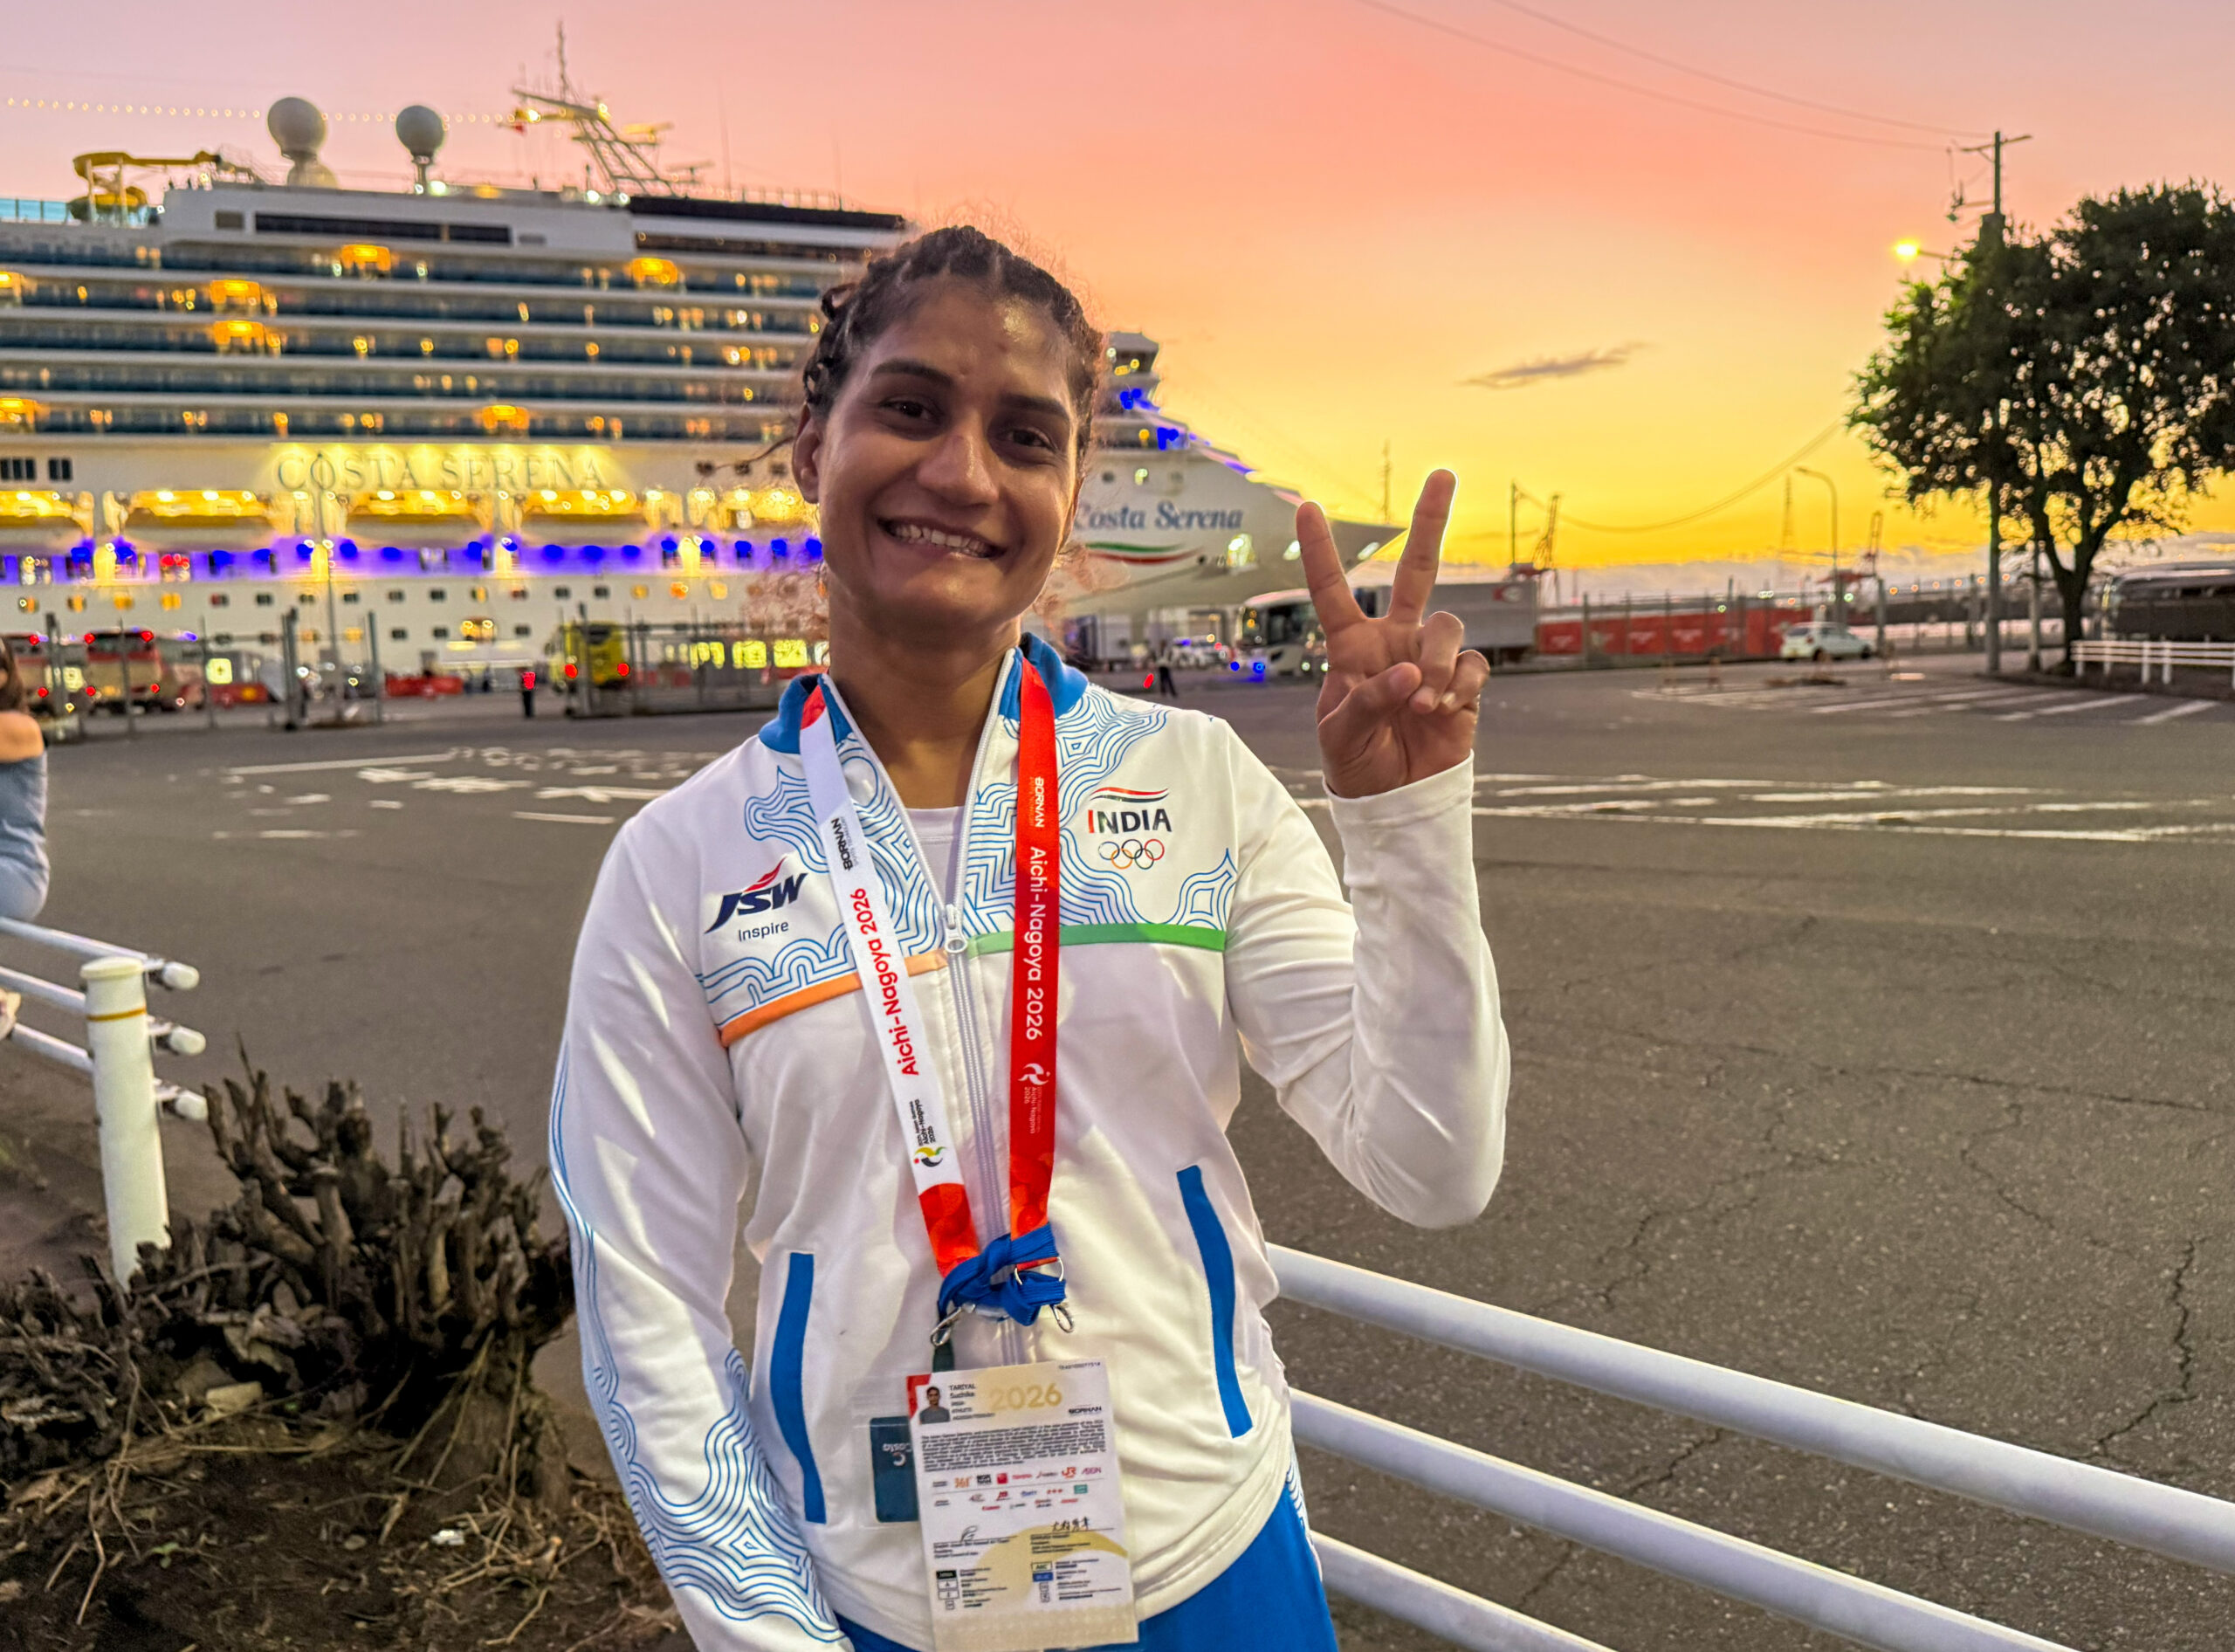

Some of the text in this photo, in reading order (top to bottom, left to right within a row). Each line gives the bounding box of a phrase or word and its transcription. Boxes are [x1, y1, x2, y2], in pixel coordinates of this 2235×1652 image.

[278, 455, 609, 491] COSTA SERENA
[1154, 500, 1245, 530] Serena
[1035, 776, 1045, 828] BORNAN
[1088, 809, 1173, 834] INDIA
[830, 817, 854, 871] BORNAN
[704, 873, 808, 935] JSW
[738, 921, 790, 942] Inspire
[1023, 846, 1048, 1041] Aichi-Nagoya 2026
[849, 887, 919, 1077] Aichi-Nagoya 2026
[991, 1382, 1062, 1411] 2026
